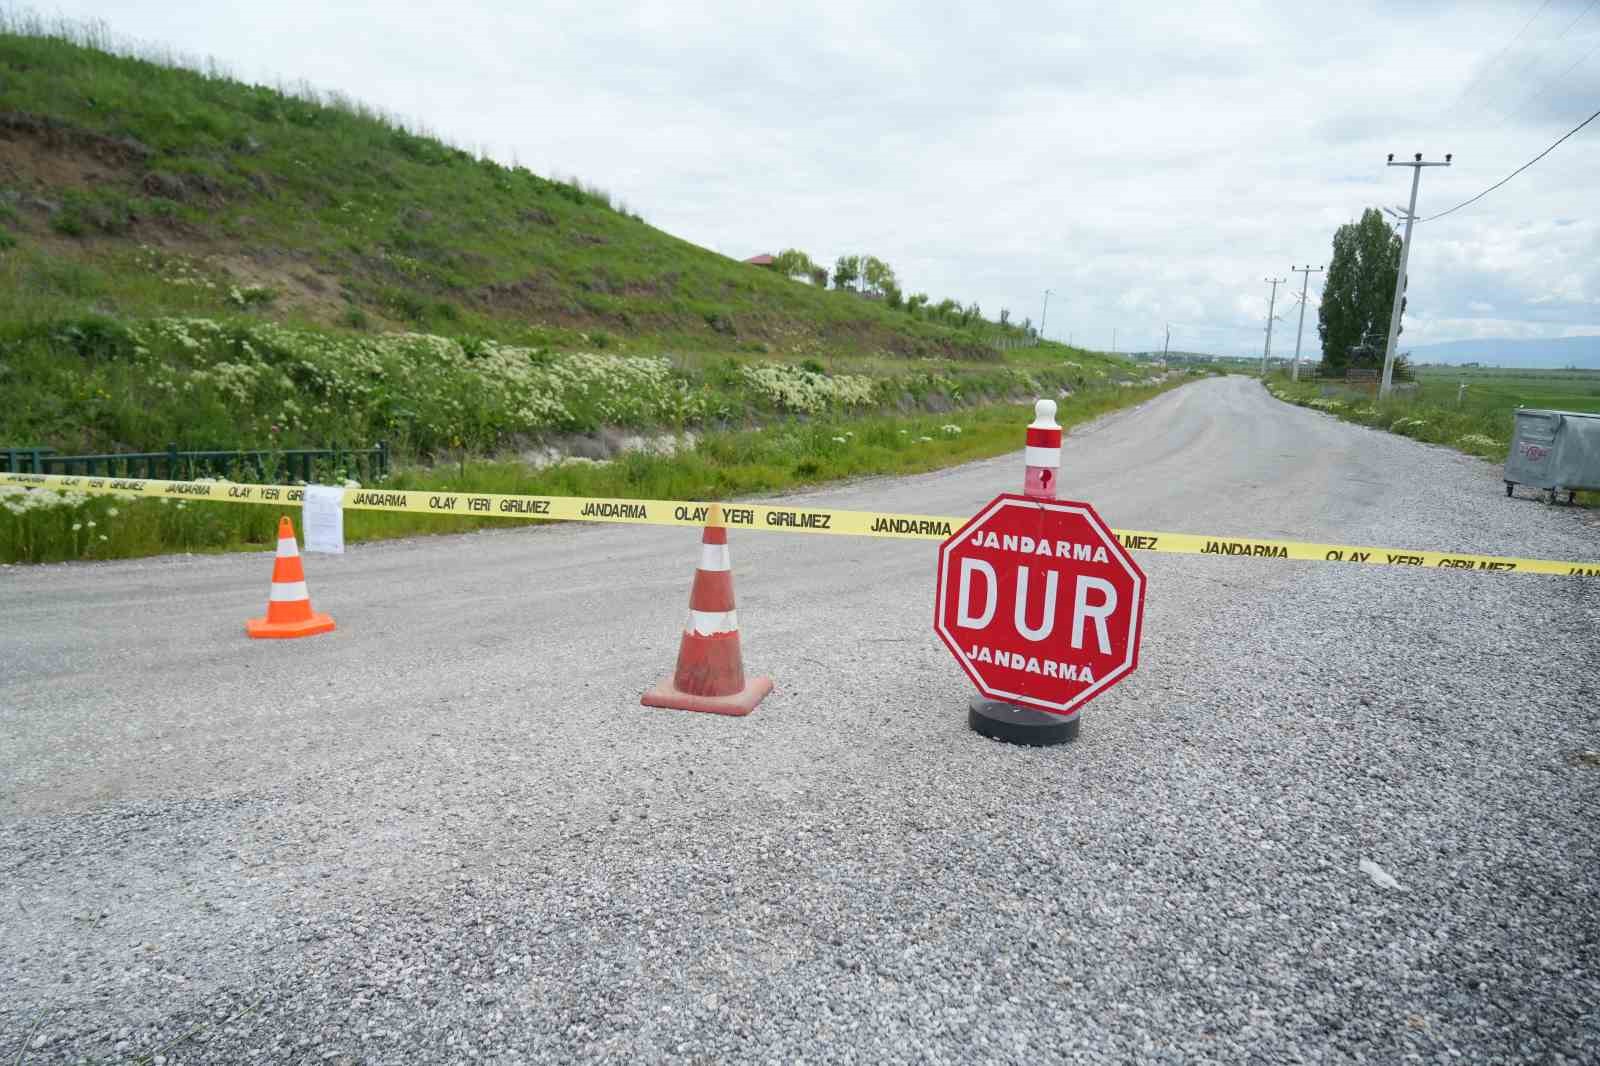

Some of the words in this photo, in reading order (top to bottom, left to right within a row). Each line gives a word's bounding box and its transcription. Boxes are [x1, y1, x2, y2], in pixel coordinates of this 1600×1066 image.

[165, 484, 211, 496] JANDARMA
[228, 486, 252, 498] OLAY
[353, 493, 407, 507] JANDARMA
[429, 496, 457, 510] OLAY
[581, 502, 648, 519] JANDARMA
[674, 506, 709, 522] OLAY
[870, 518, 952, 536] JANDARMA
[1200, 541, 1289, 559] JANDARMA
[971, 530, 1109, 564] JANDARMA
[956, 556, 1118, 656] DUR
[966, 645, 1095, 684] JANDARMA
